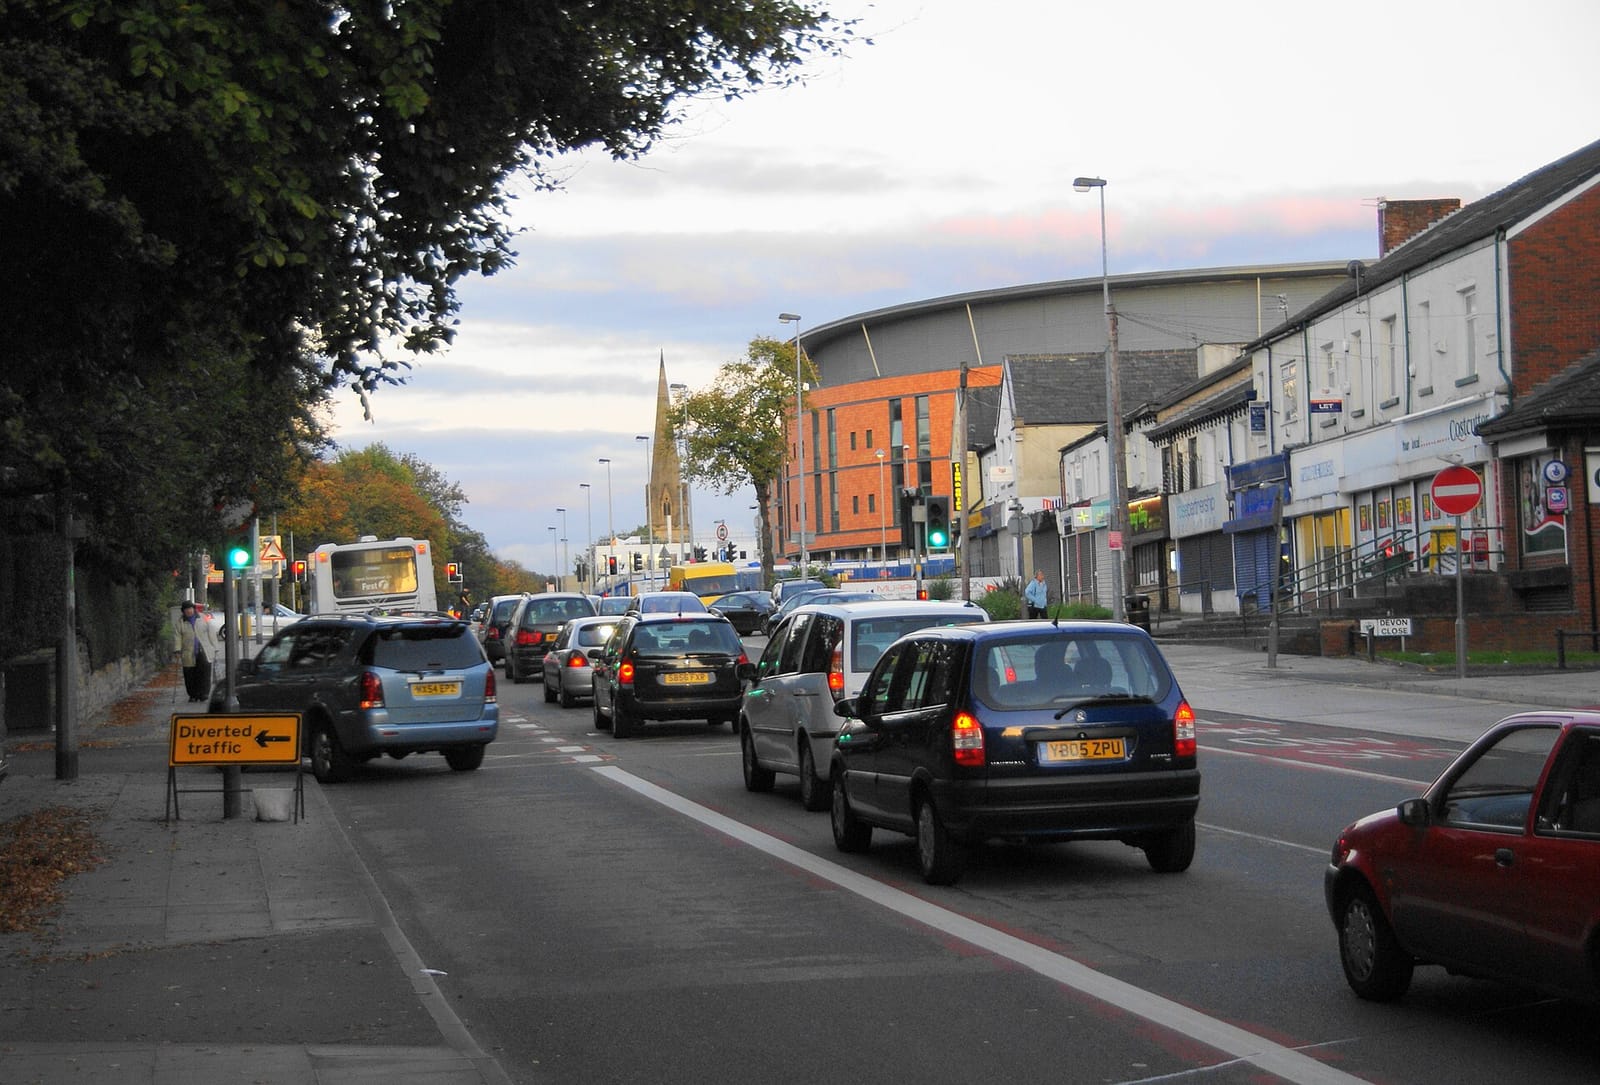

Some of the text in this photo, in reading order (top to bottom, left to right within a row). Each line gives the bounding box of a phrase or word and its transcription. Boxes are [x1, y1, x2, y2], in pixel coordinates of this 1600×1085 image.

[1381, 627, 1408, 635] CLOSE
[180, 725, 252, 738] Diverted
[188, 741, 241, 755] traffic
[1092, 741, 1121, 756] ZPU
